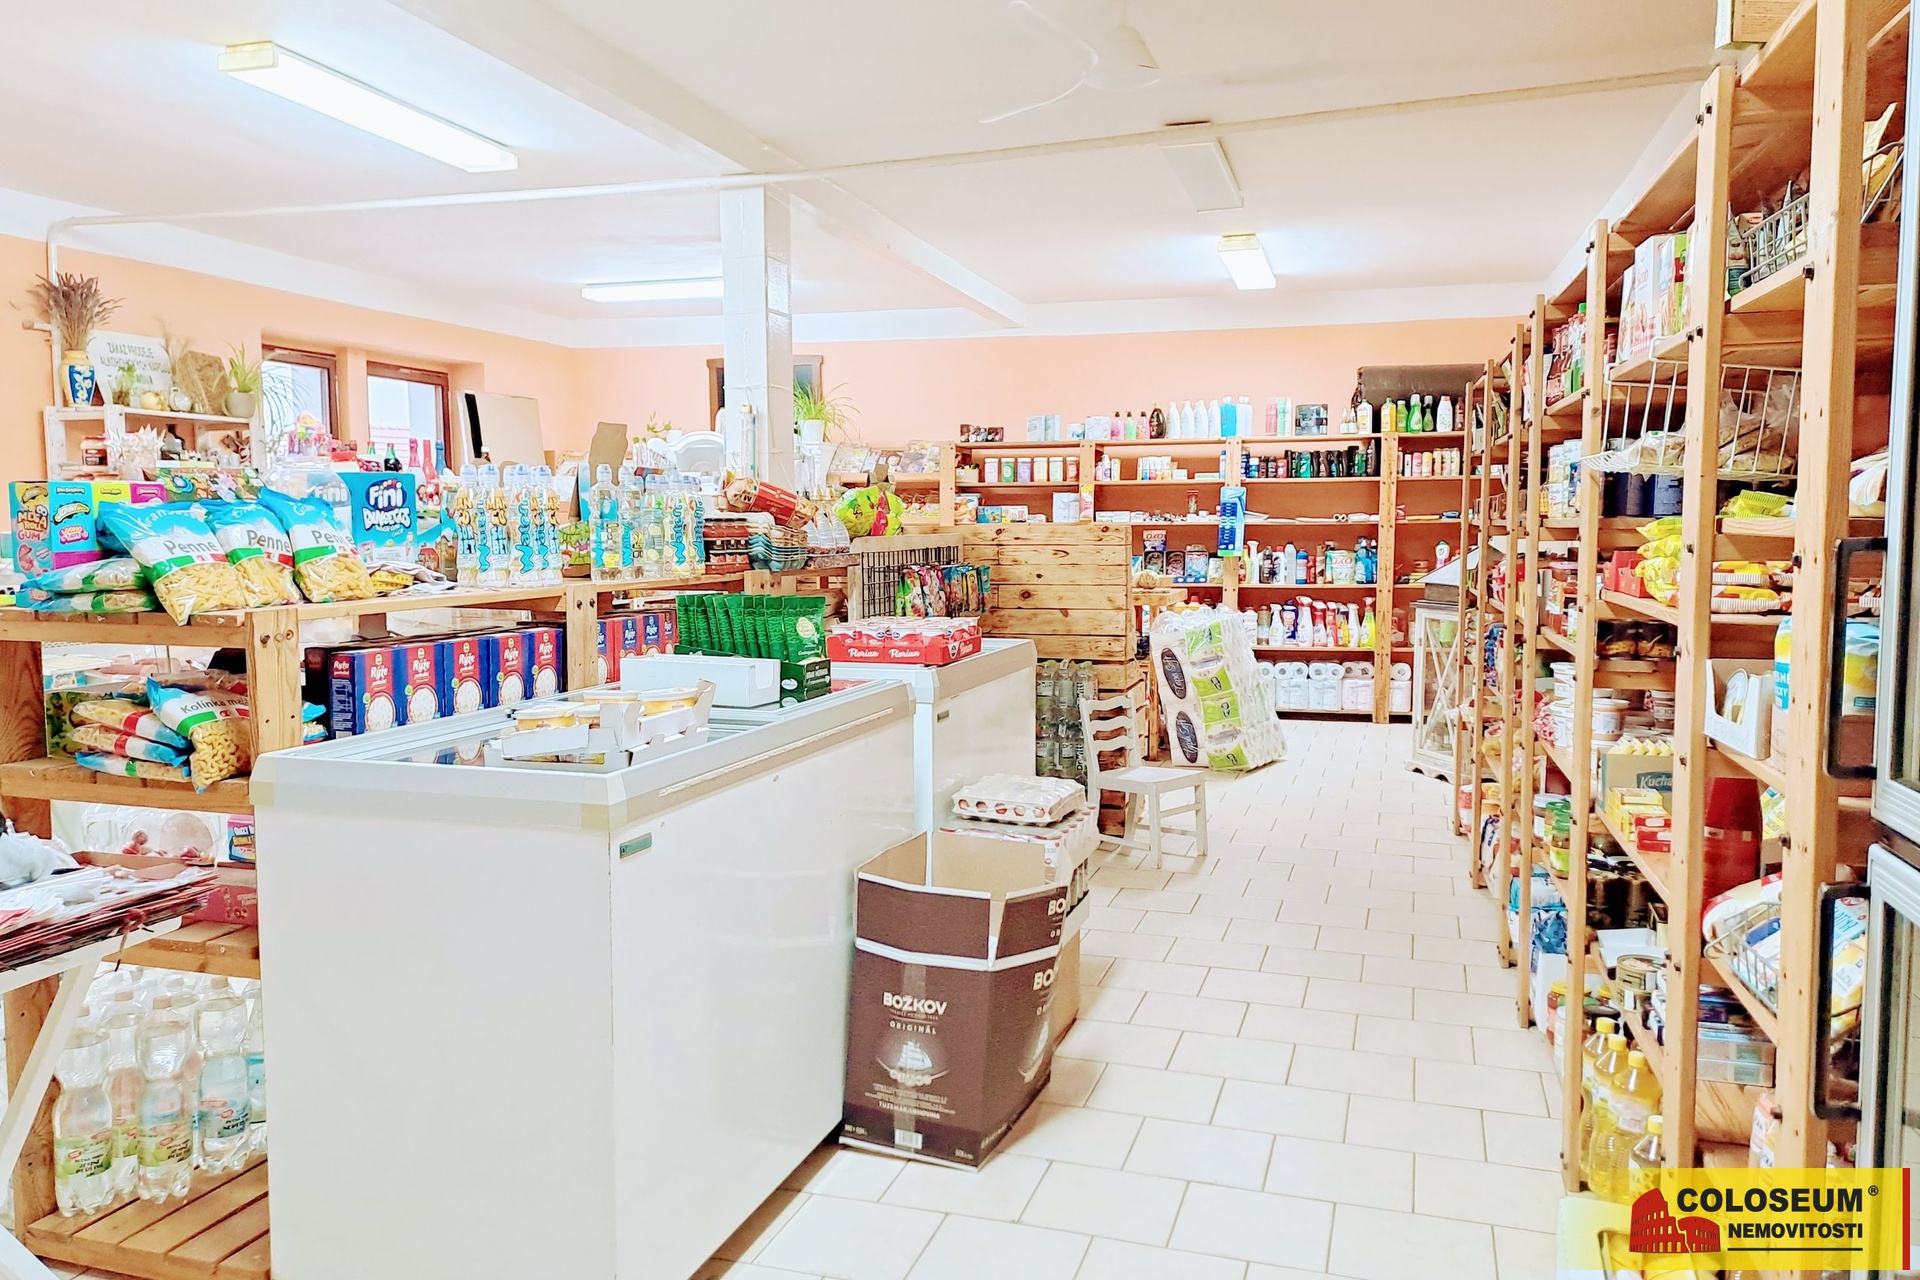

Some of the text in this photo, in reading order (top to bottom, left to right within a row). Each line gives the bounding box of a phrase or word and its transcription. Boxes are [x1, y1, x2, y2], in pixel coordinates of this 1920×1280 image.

[369, 481, 404, 509] Fini
[18, 530, 42, 541] GUM
[246, 530, 291, 552] Penne
[163, 540, 217, 555] Penne
[459, 652, 475, 666] Rýže
[848, 648, 879, 658] Florian
[889, 648, 921, 658] Florian
[371, 665, 388, 679] Rýže
[413, 658, 430, 672] Rýže
[180, 699, 226, 714] Kolínka
[883, 991, 947, 1016] BOŽKOV
